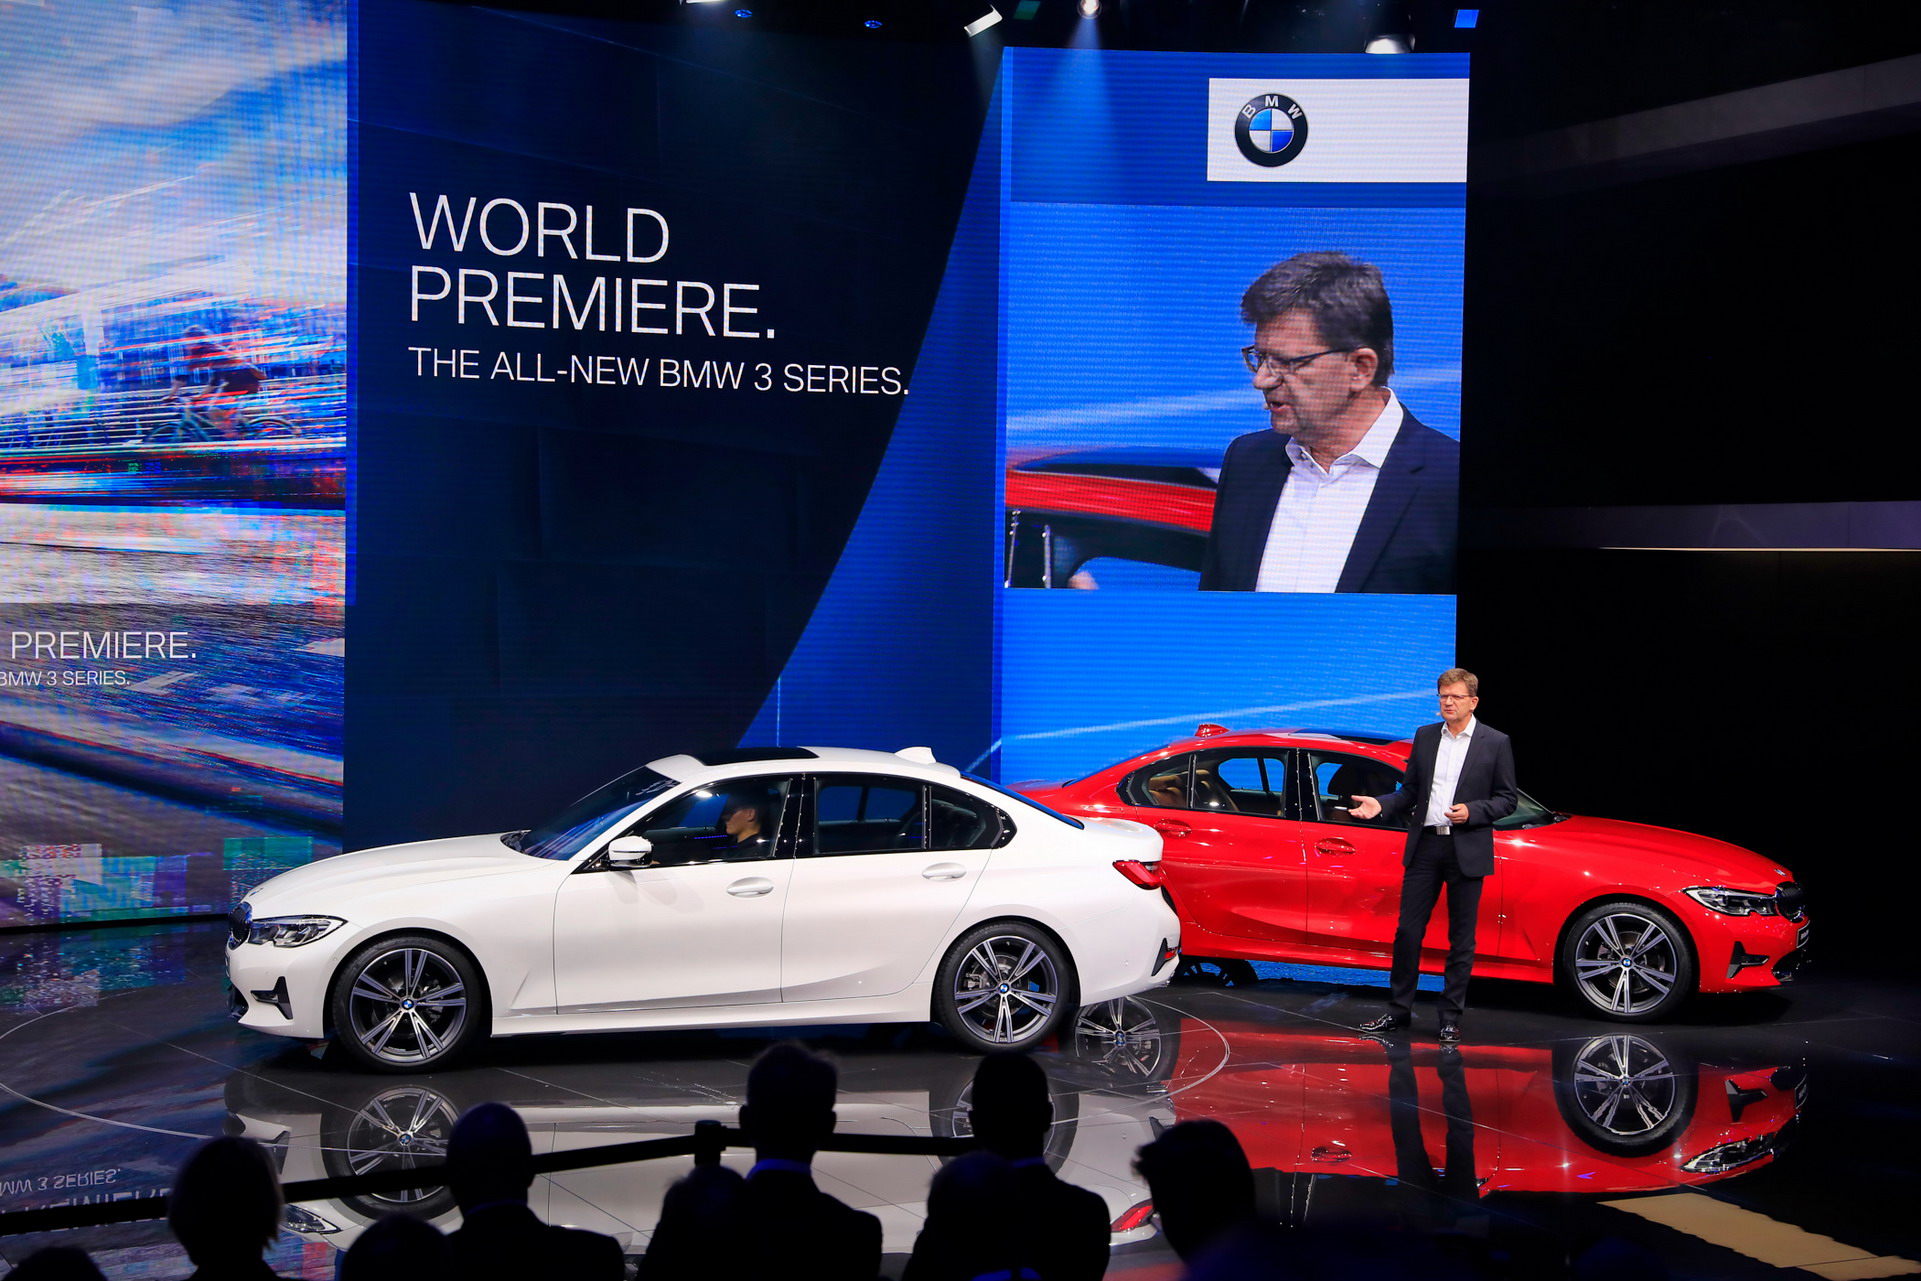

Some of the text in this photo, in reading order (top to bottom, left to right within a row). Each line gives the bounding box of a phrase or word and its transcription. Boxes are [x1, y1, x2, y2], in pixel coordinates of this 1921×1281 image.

[1241, 95, 1303, 120] BMW
[408, 191, 670, 264] WORLD
[411, 264, 775, 339] PREMIERE.
[407, 346, 909, 396] THE ALL-NEW BMW 3 SERIES.
[11, 631, 197, 660] PREMIERE.
[0, 670, 130, 686] BMW 3 SERIES.
